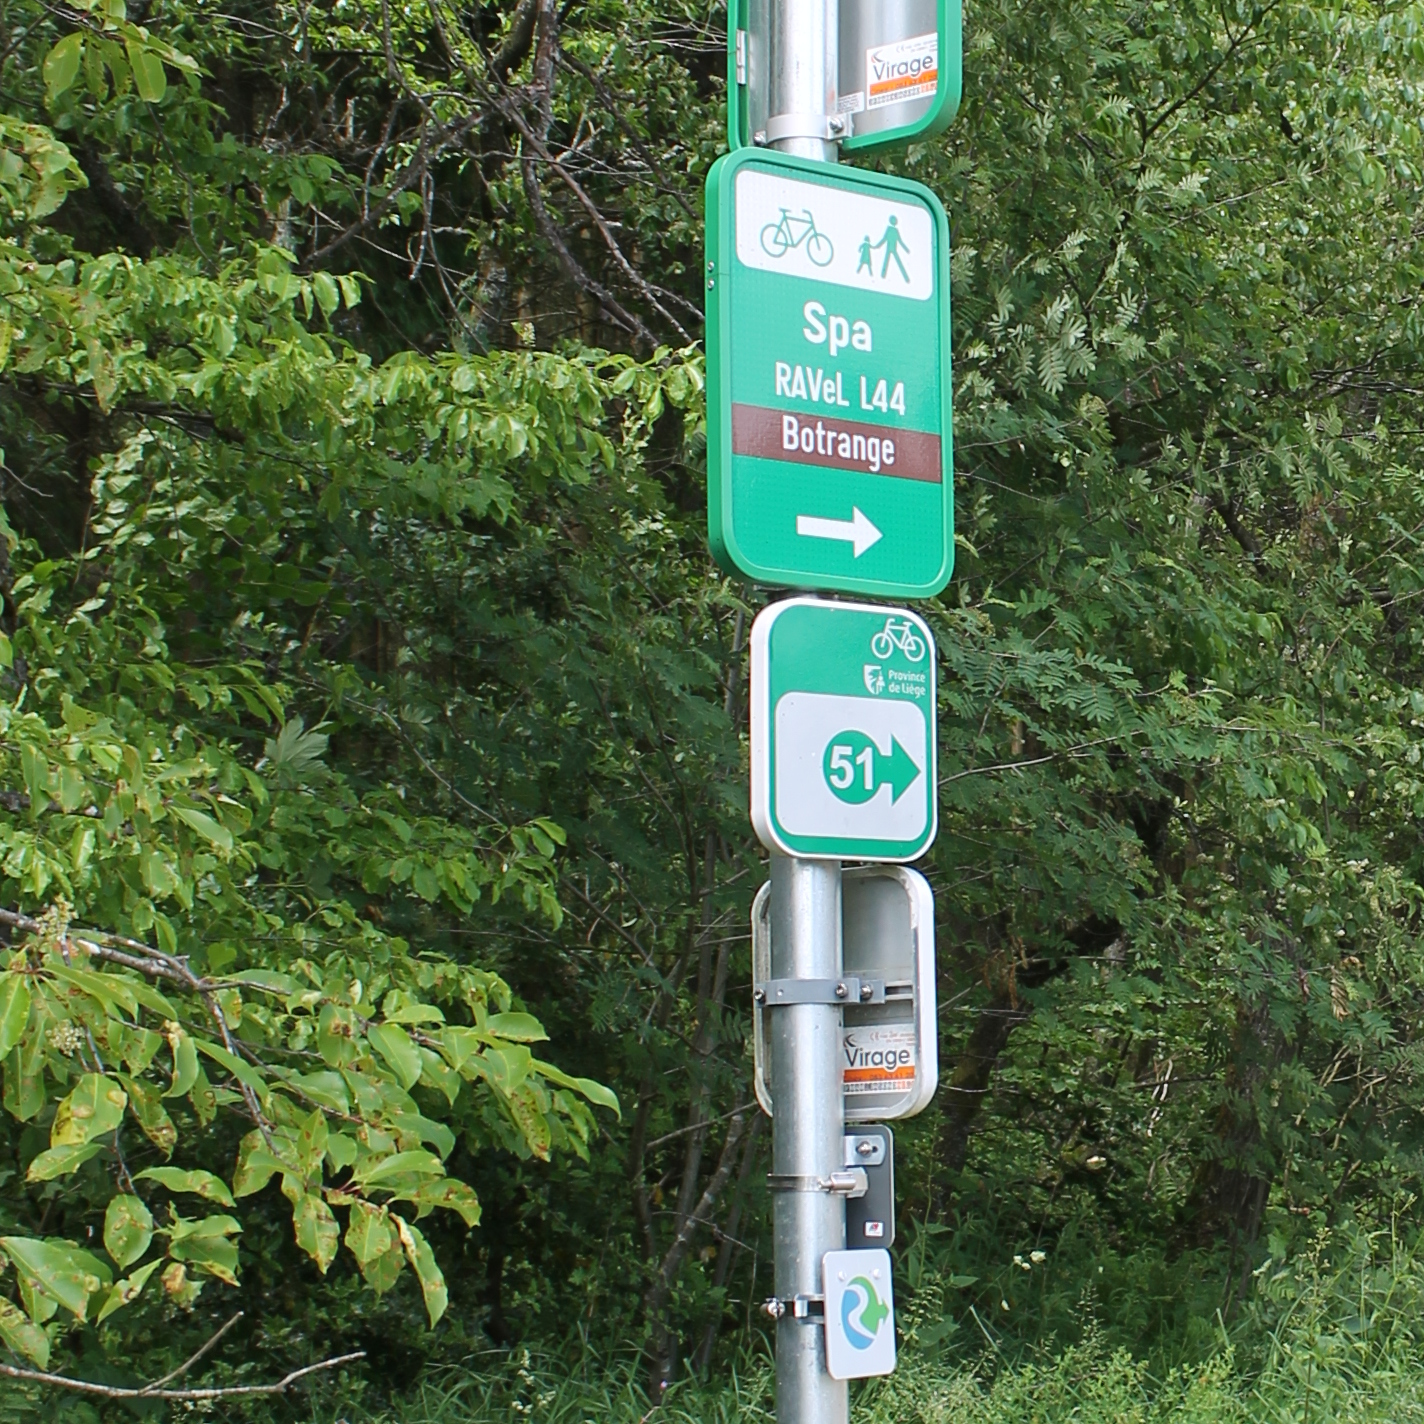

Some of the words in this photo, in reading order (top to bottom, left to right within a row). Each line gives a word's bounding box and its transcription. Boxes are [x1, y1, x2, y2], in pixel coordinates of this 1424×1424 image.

[873, 56, 933, 80] Virage
[803, 301, 872, 356] Spa
[776, 362, 849, 407] RAVeL
[860, 377, 906, 416] L44
[783, 415, 895, 472] Botrange
[888, 669, 926, 682] Province
[888, 681, 900, 694] de
[901, 682, 926, 699] Liège
[830, 745, 873, 790] 51
[845, 1048, 910, 1070] Virage
